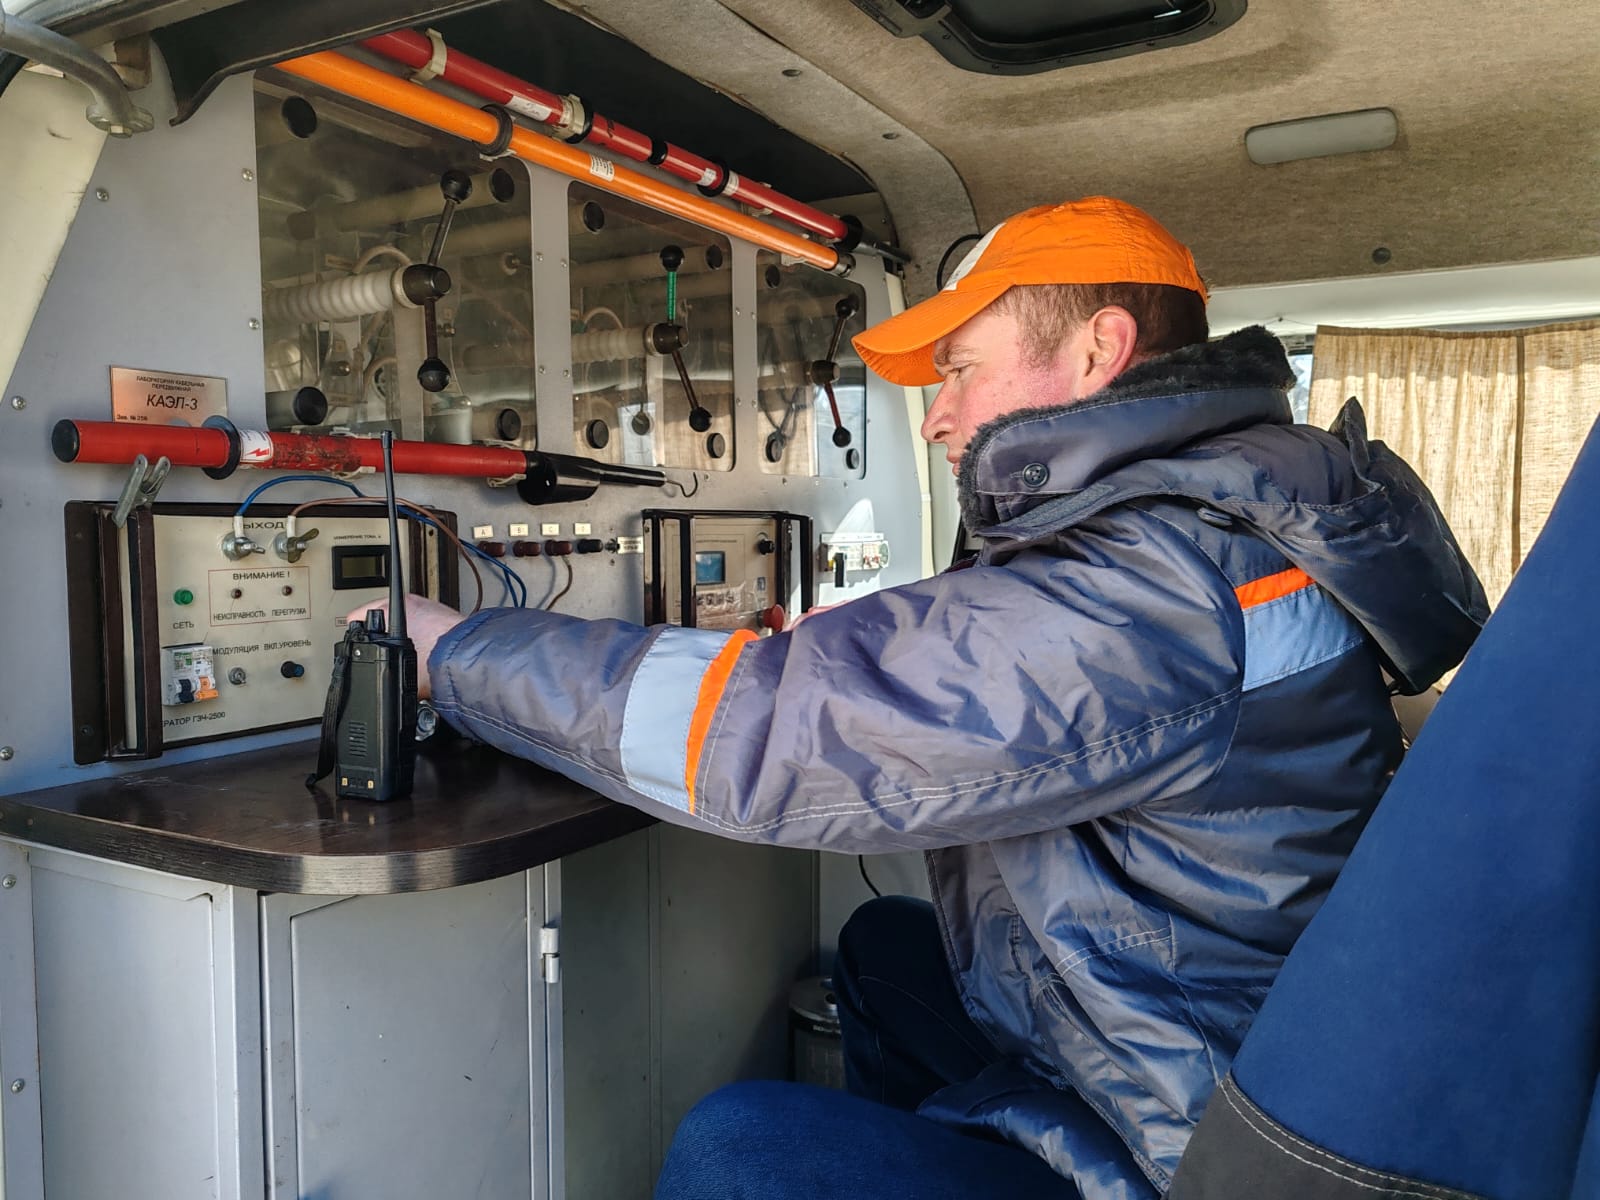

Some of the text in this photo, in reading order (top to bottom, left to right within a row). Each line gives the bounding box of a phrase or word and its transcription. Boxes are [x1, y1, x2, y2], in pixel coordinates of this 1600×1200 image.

[146, 394, 198, 410] КАЭЛ-3
[243, 521, 285, 529] ЫХОД
[233, 571, 285, 580] ВНИМАНИЕ
[213, 610, 266, 621] НЕИСПРАВНОСТЬ
[271, 607, 307, 616] ПЕРЕГРУЗКА
[172, 621, 195, 629] СЕТЬ
[212, 644, 259, 656] МОДУЛЯЦИЯ
[162, 716, 191, 727] РАТОР
